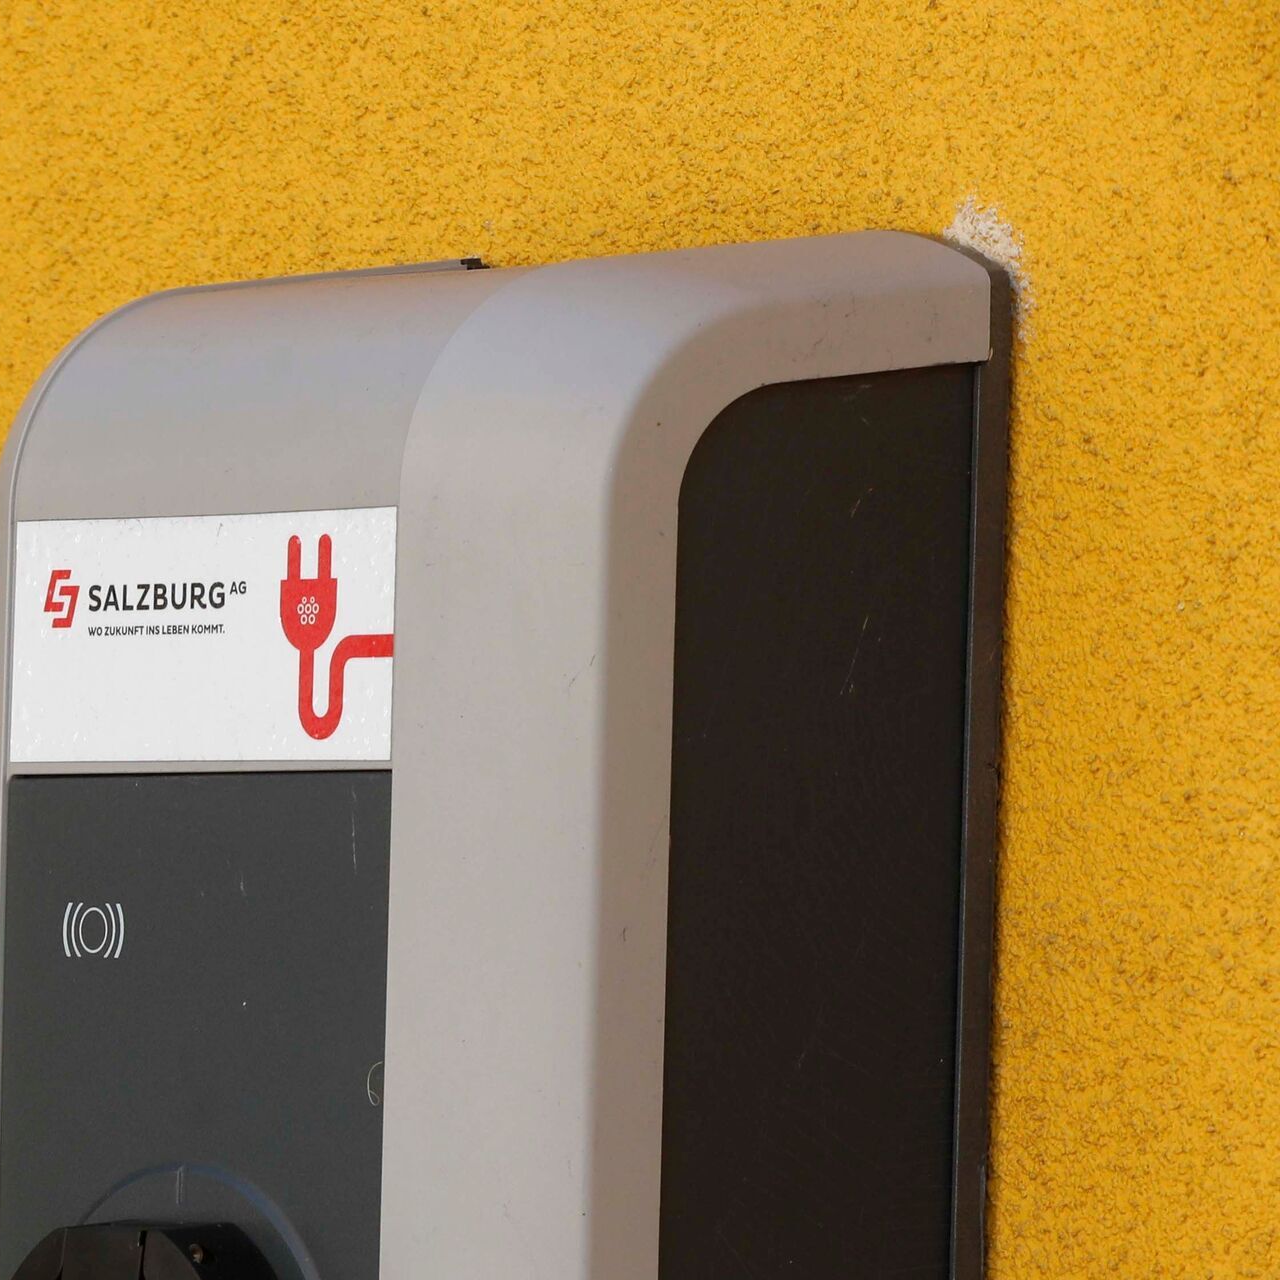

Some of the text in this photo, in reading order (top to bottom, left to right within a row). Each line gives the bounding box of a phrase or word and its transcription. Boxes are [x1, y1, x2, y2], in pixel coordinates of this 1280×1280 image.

[88, 581, 247, 612] SALZBURG AG
[88, 624, 225, 636] WO ZUKUNFT INS LEBEN KOMMT.
